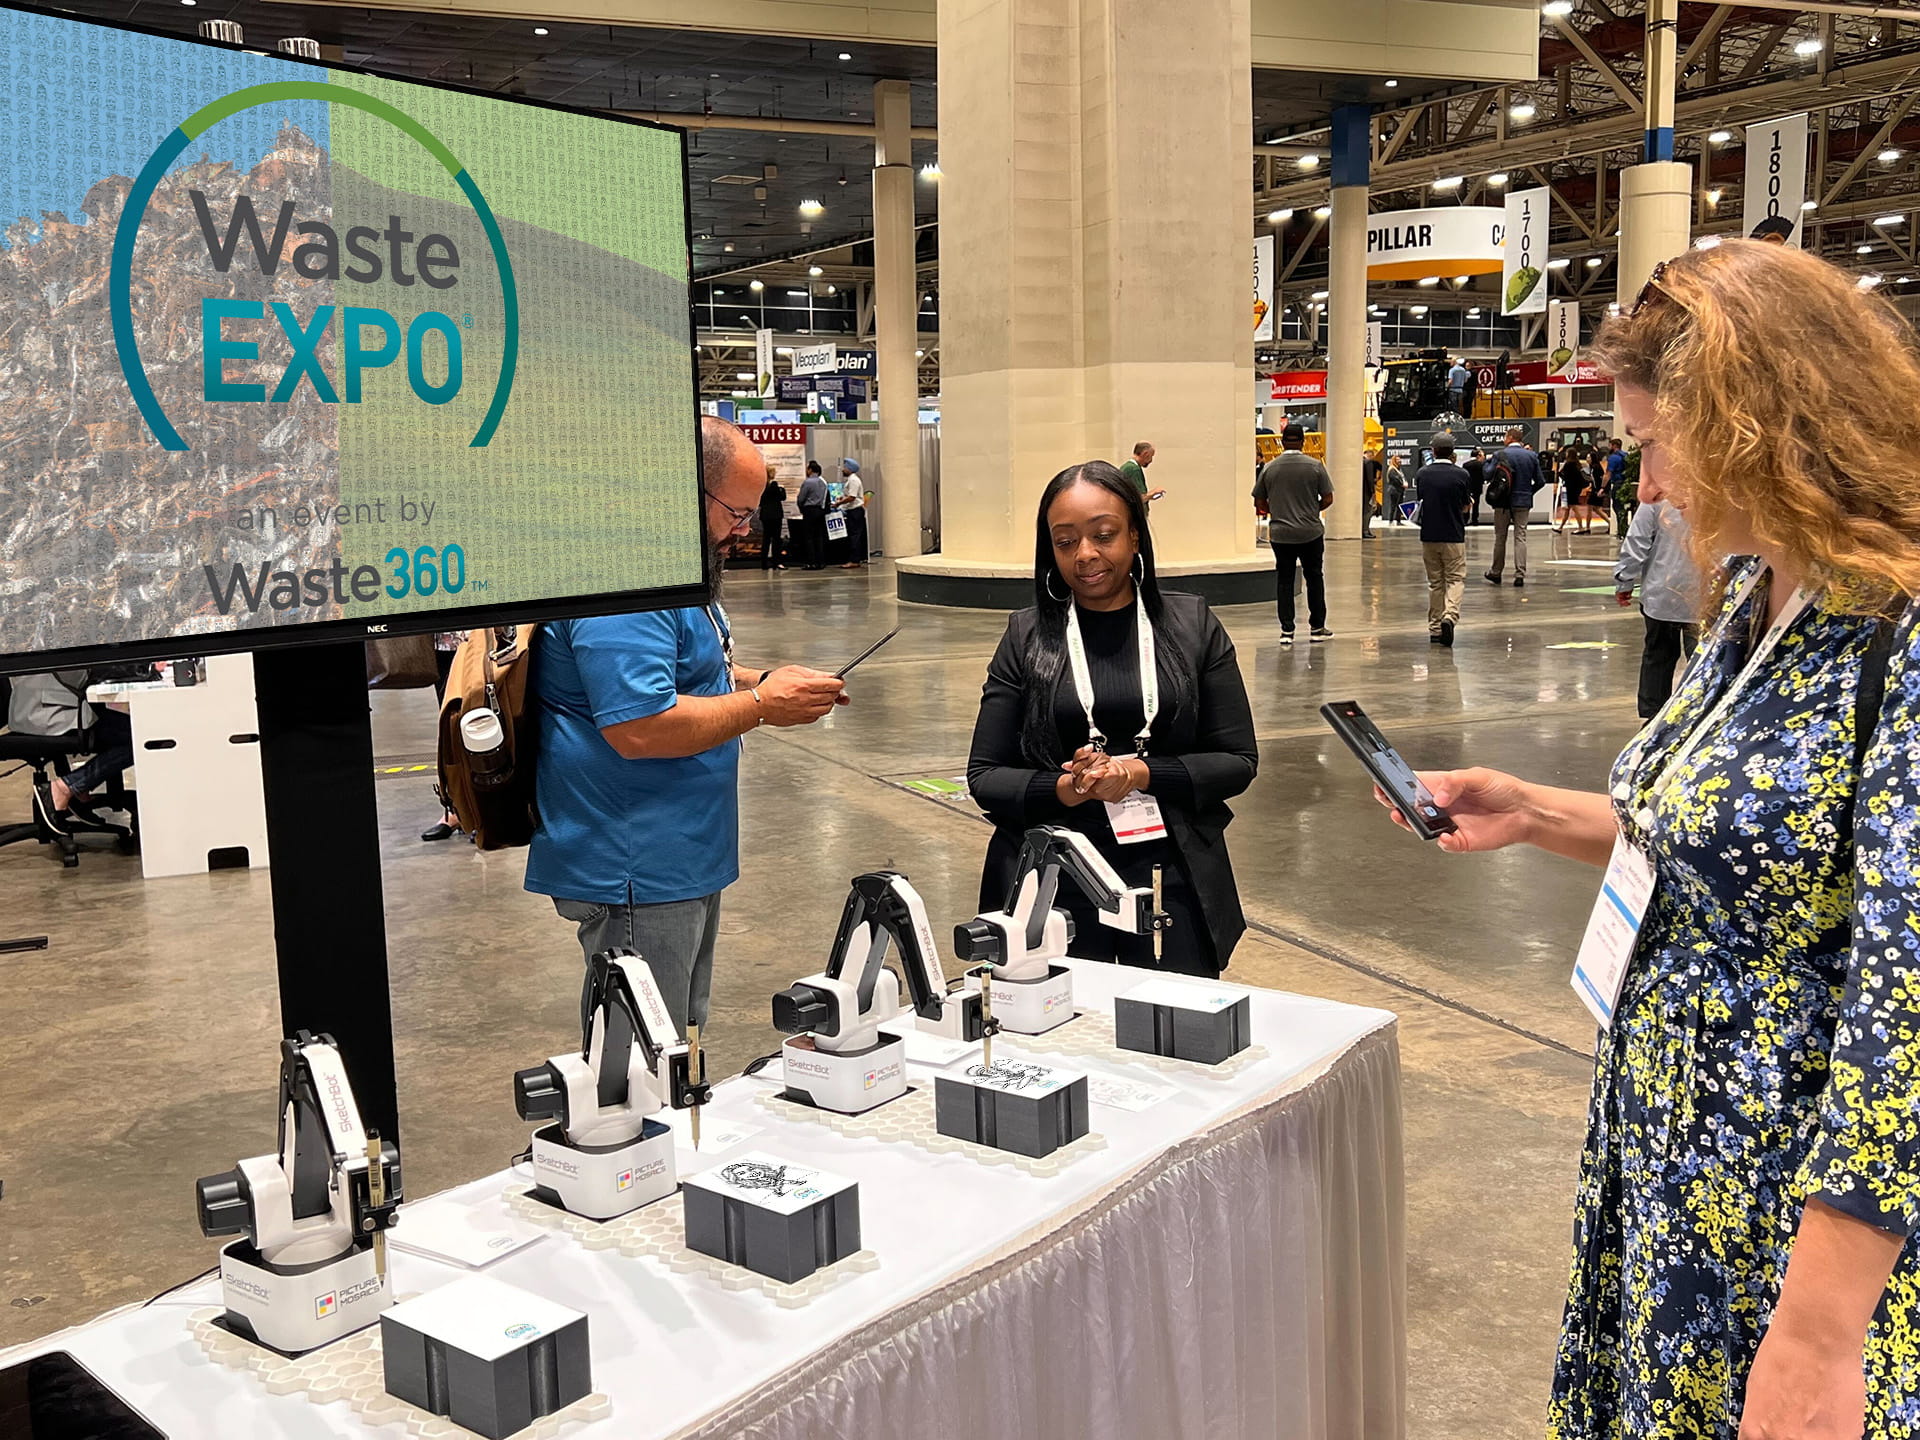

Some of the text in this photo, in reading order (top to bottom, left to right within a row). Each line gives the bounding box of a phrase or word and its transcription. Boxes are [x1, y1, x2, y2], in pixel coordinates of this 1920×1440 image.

[1767, 130, 1781, 219] 1800
[189, 190, 460, 290] Waste
[1521, 199, 1531, 268] 1700
[236, 494, 437, 530] an event by
[367, 624, 388, 634] NEC
[339, 1277, 377, 1298] PICTURE
[340, 1285, 380, 1307] MOSAICS
